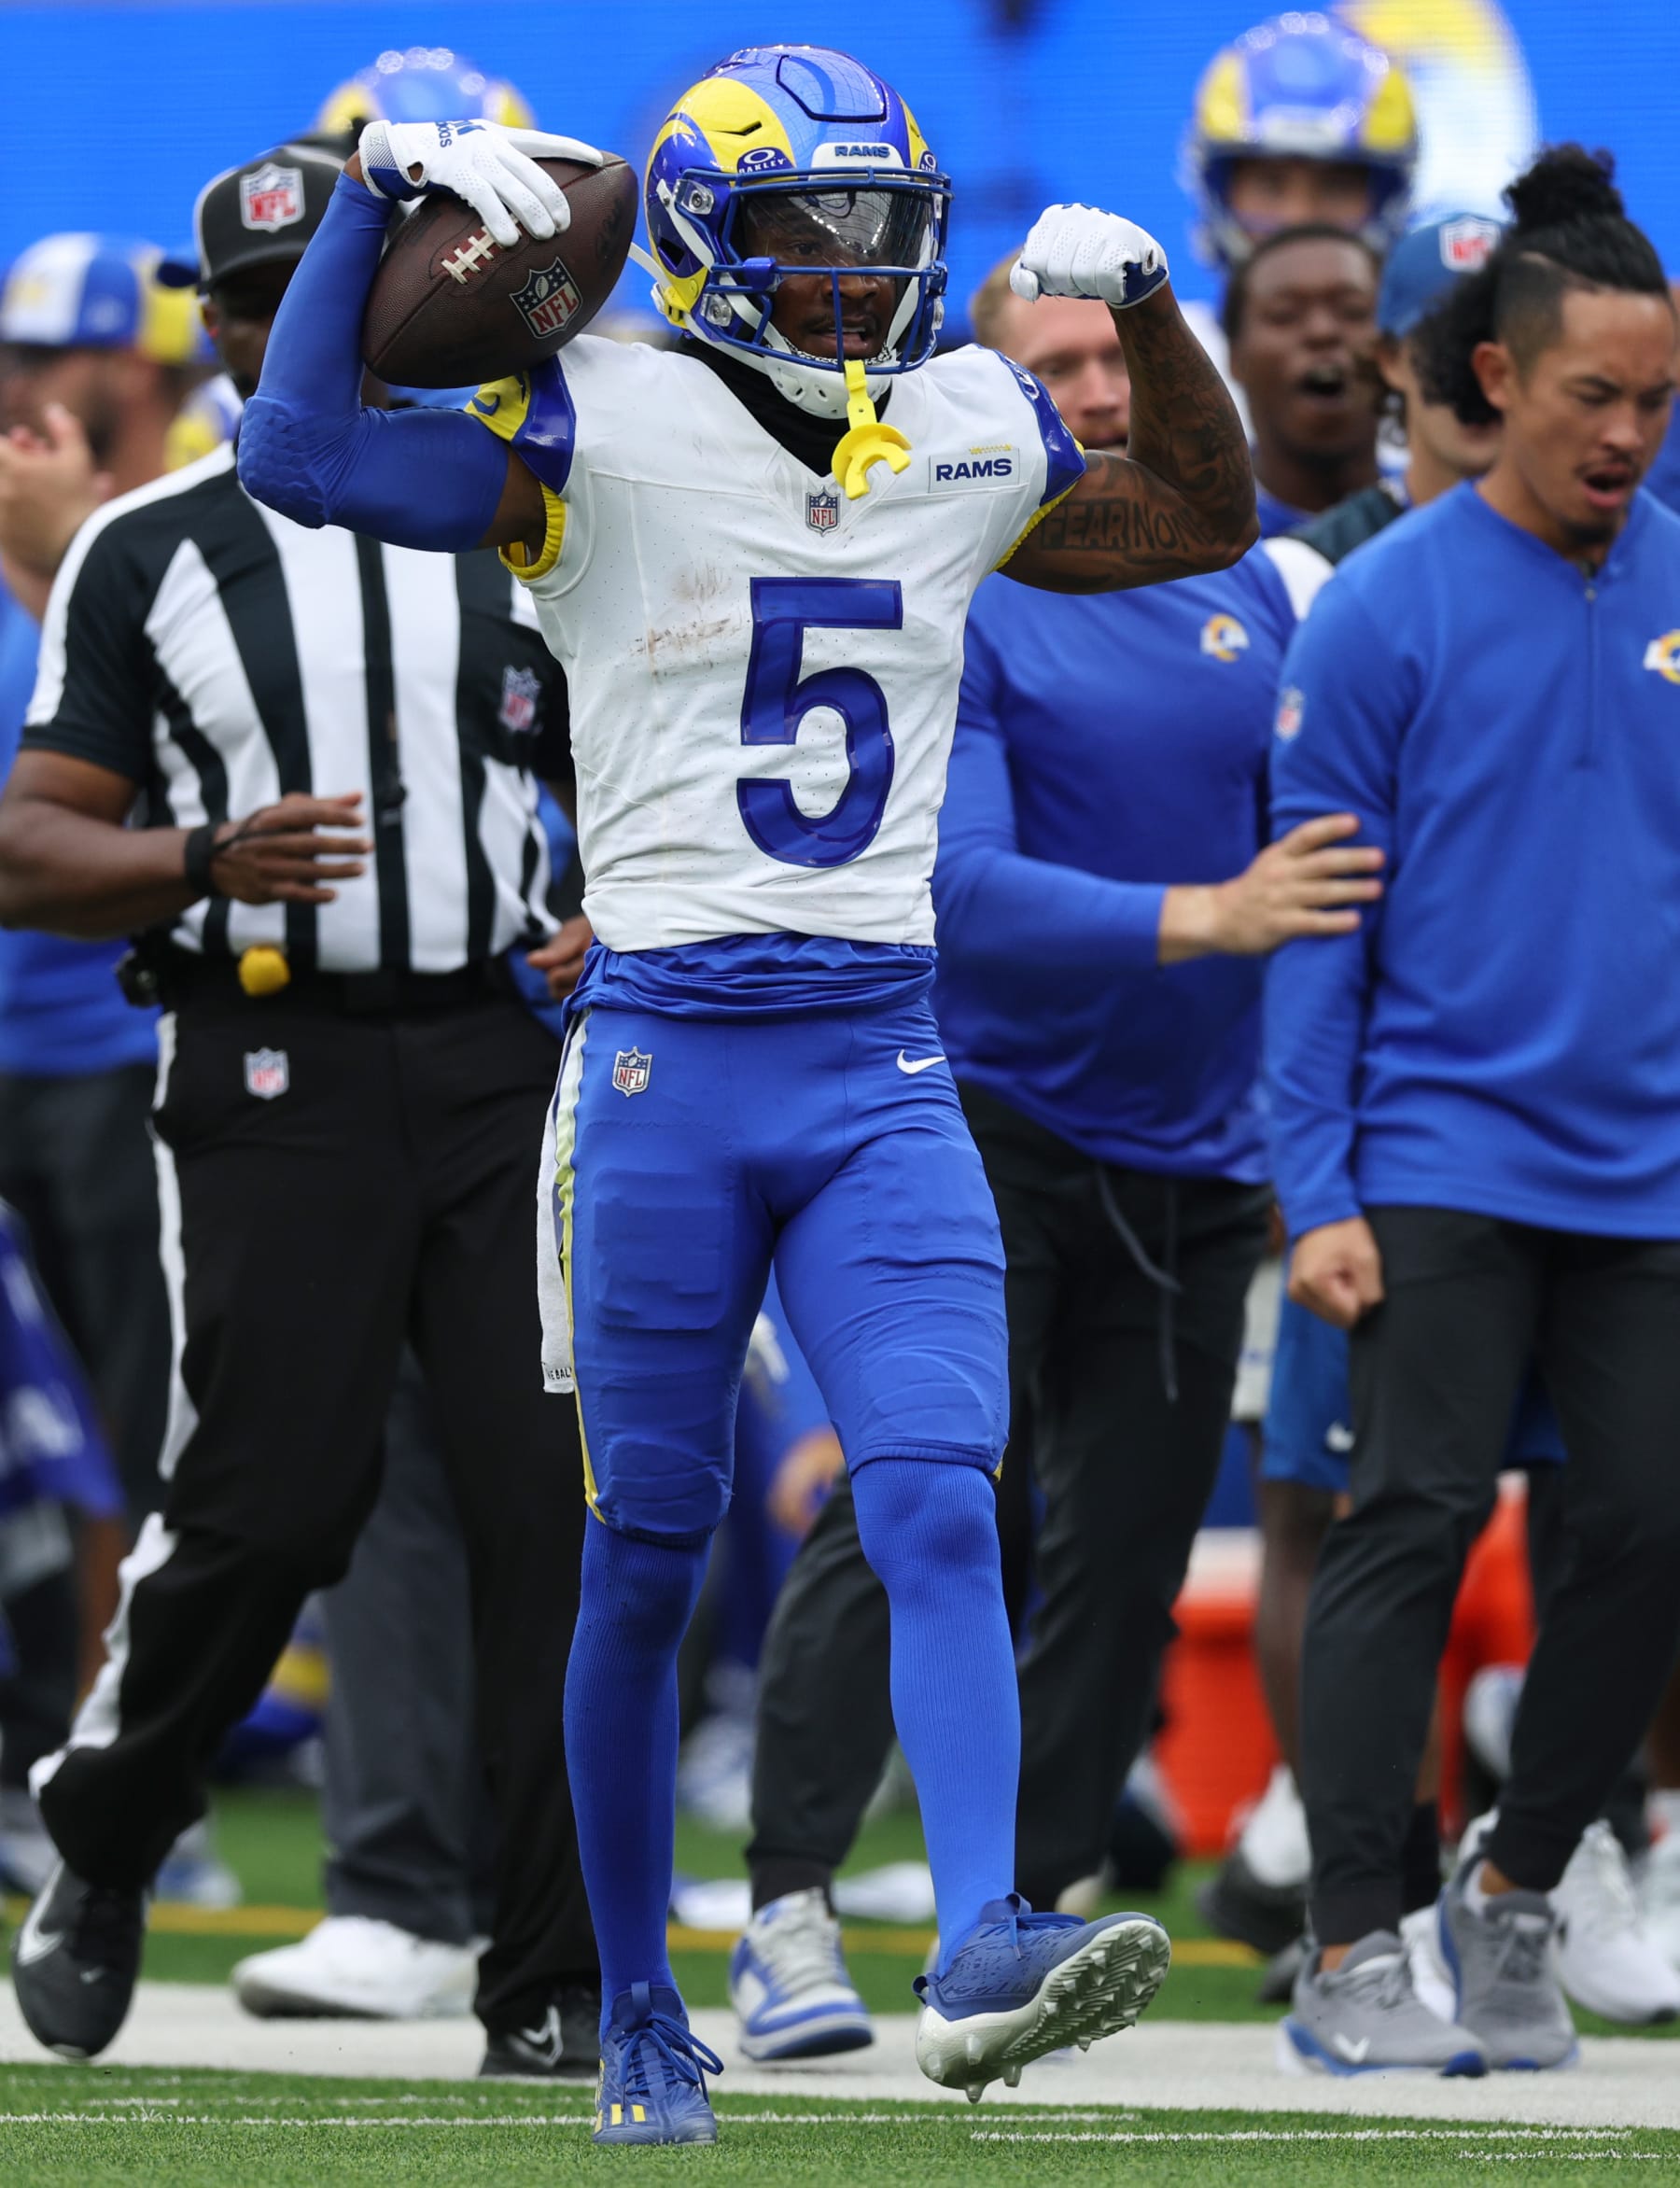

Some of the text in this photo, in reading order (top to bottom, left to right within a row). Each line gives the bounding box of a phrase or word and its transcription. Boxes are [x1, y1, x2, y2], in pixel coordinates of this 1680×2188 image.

[834, 146, 889, 158] RAMS
[529, 288, 579, 333] NFL
[936, 458, 1013, 482] RAMS
[812, 509, 835, 526] NFL
[736, 577, 903, 868] 5
[618, 1069, 643, 1087] NFL
